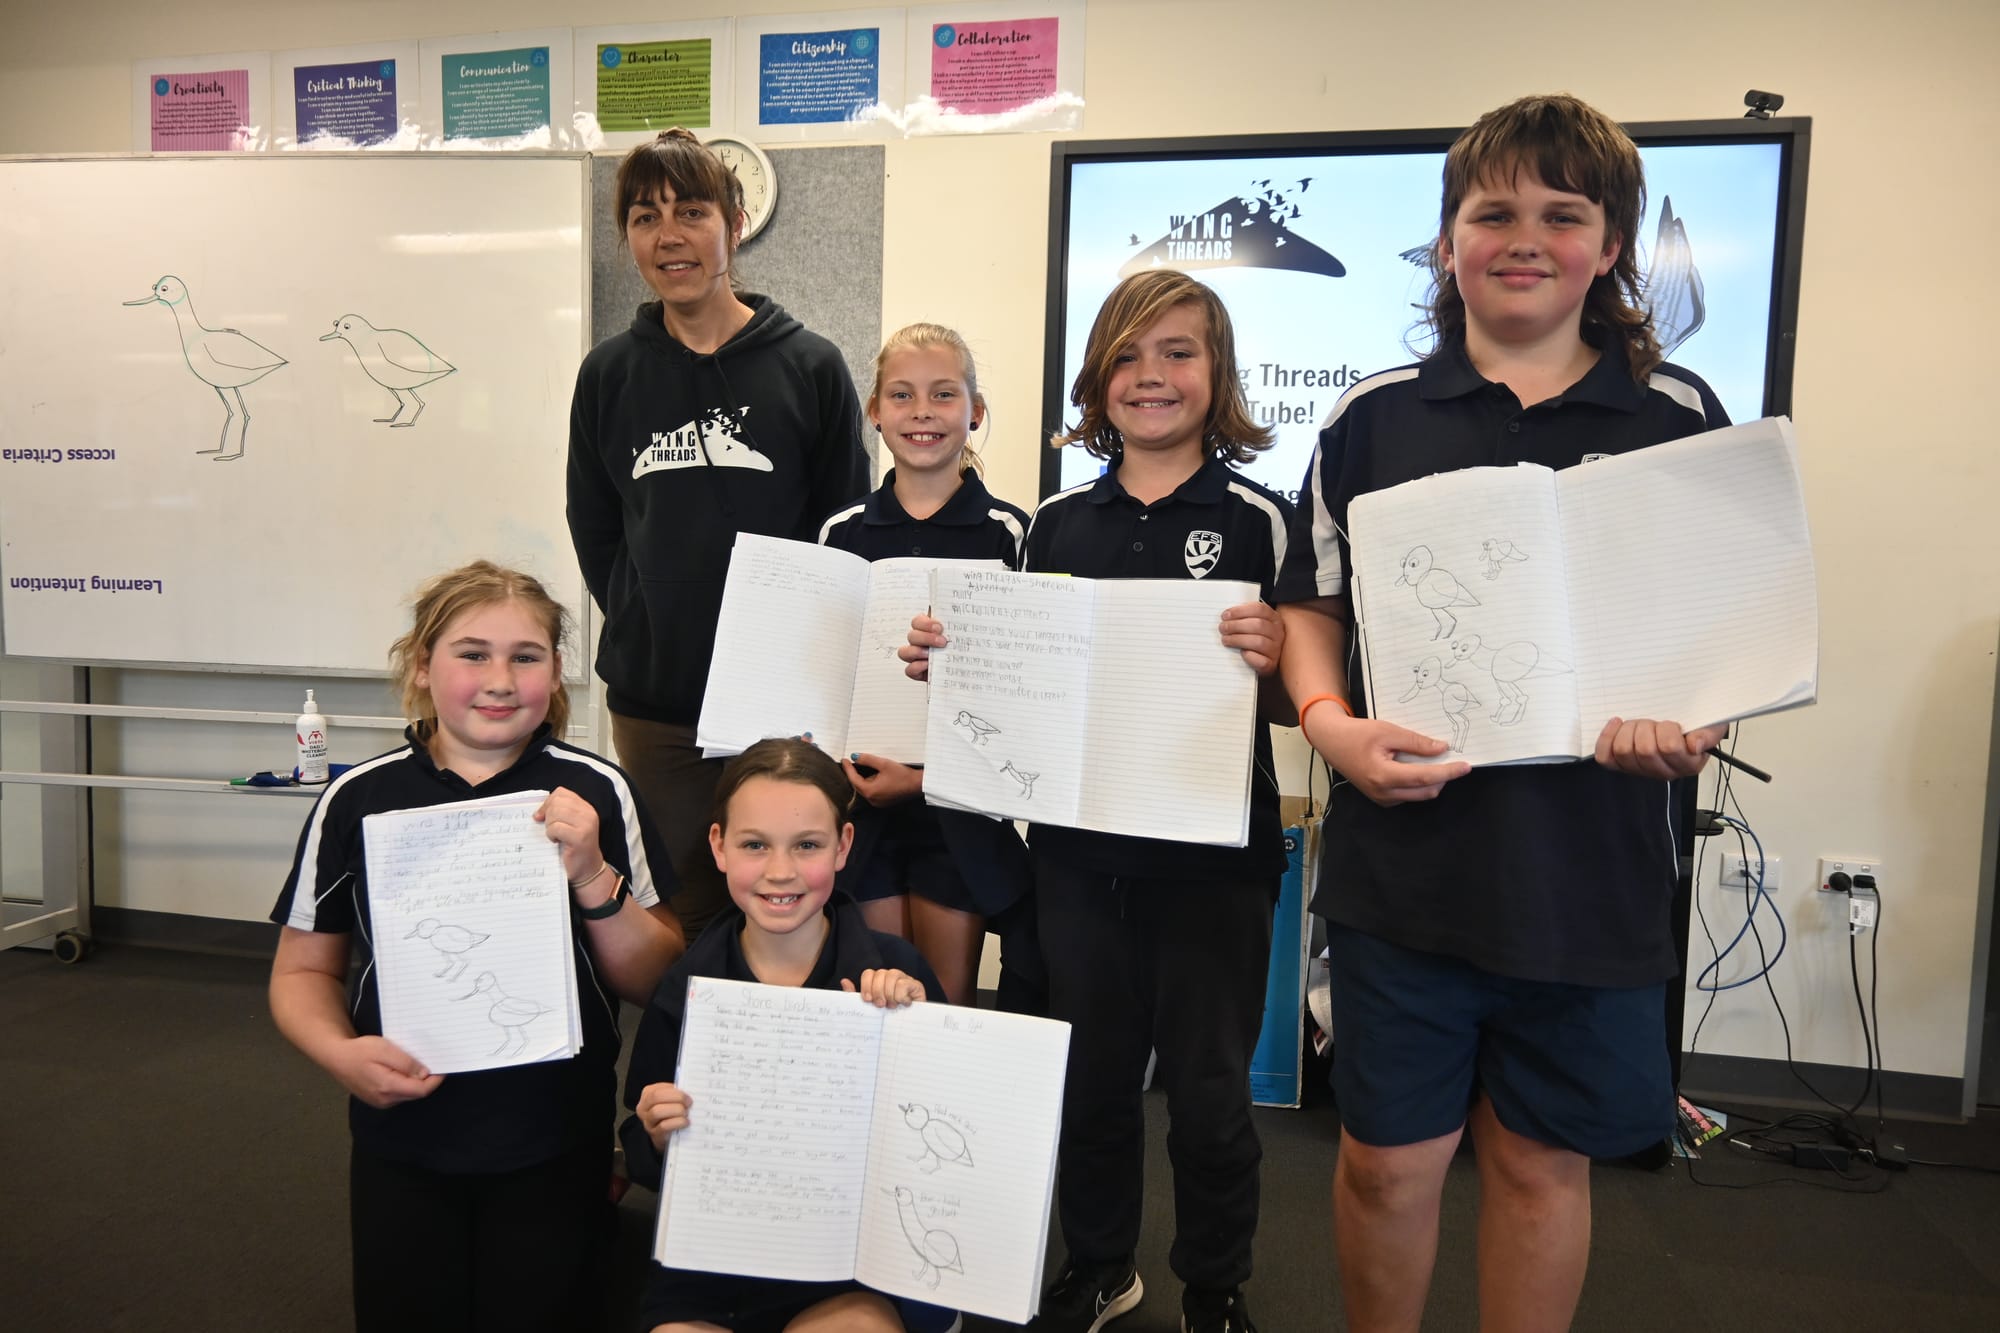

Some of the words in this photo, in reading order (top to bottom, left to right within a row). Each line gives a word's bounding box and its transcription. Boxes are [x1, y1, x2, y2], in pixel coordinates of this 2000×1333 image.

[958, 30, 1031, 46] Collaboration
[792, 38, 847, 57] Citizenship
[628, 48, 681, 64] Character
[460, 61, 530, 77] Communication
[174, 80, 224, 96] Creativity
[308, 77, 344, 92] Critical
[347, 75, 382, 91] Thinking
[752, 166, 759, 176] 2
[757, 185, 764, 194] 3
[1170, 212, 1232, 239] WING
[1166, 241, 1232, 261] THREADS
[652, 431, 695, 448] WING
[3, 449, 62, 463] Criteria
[651, 450, 696, 462] THREADS
[1190, 532, 1220, 544] EFS
[10, 577, 86, 592] Intention
[91, 576, 162, 594] Learning
